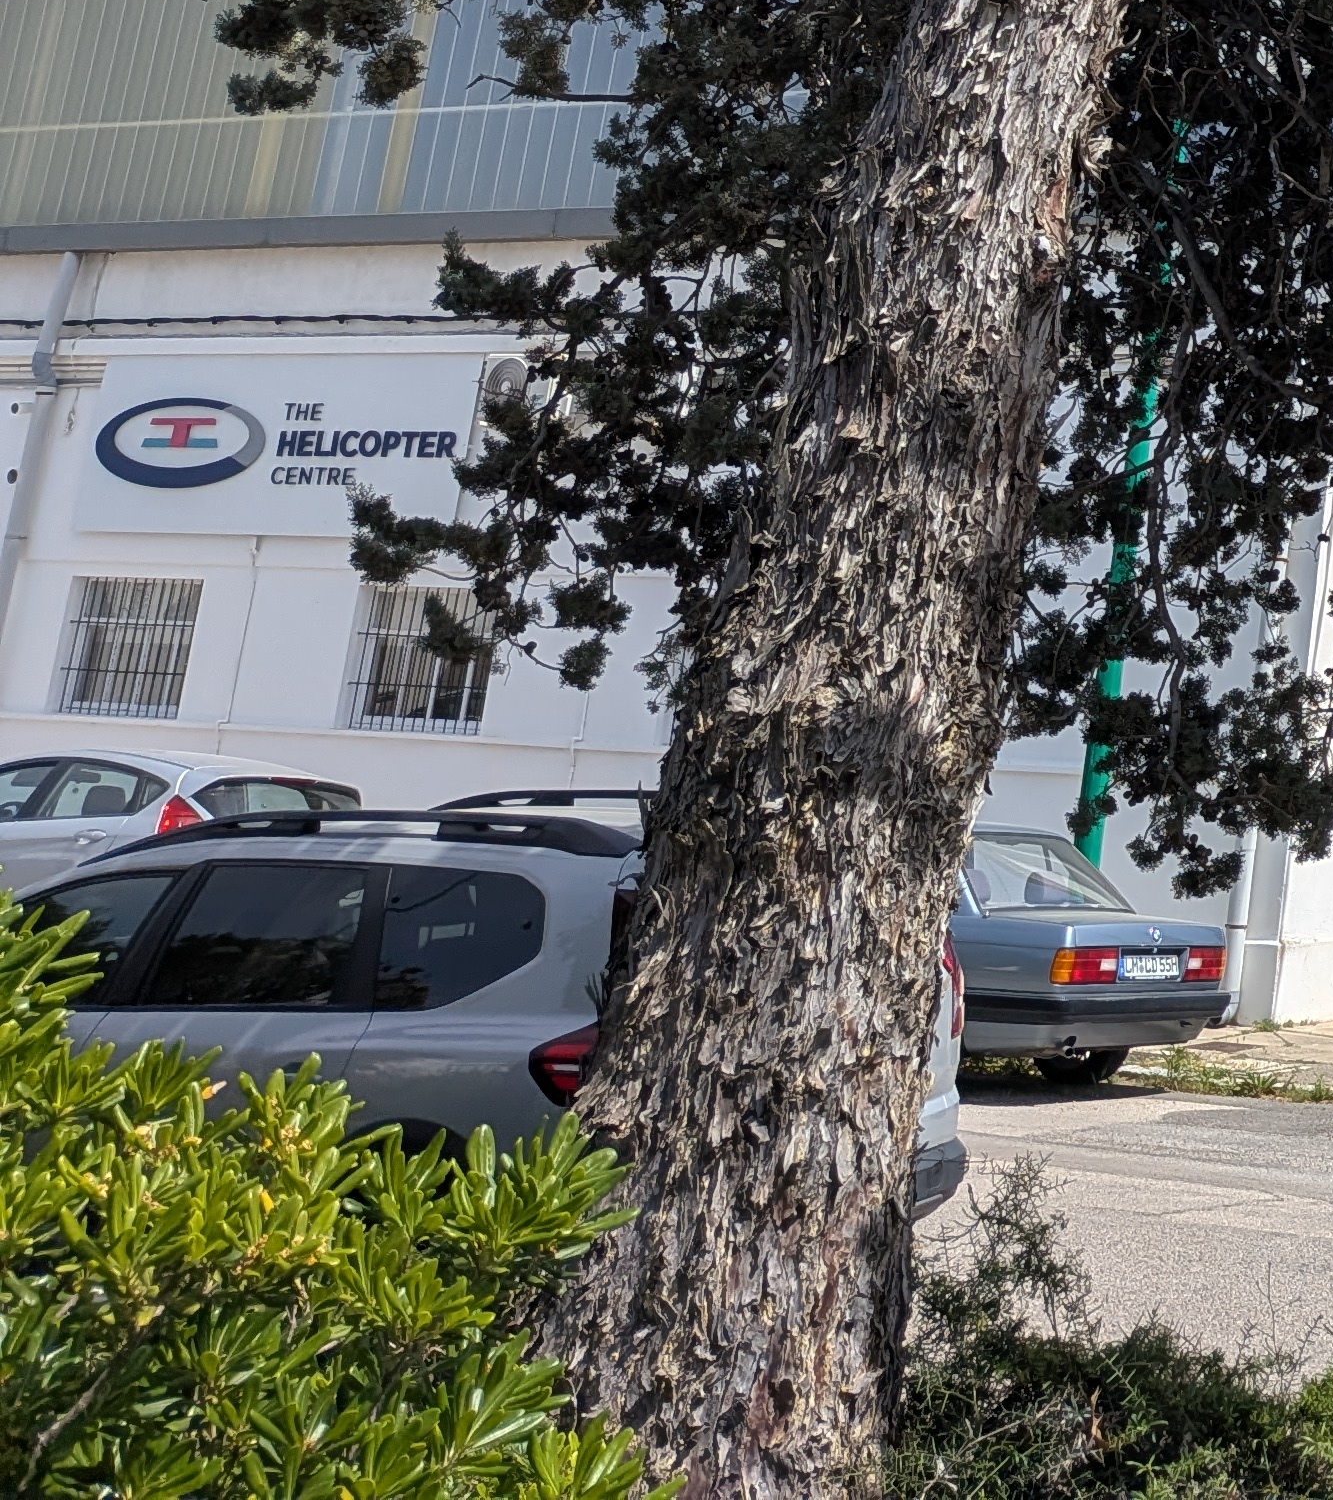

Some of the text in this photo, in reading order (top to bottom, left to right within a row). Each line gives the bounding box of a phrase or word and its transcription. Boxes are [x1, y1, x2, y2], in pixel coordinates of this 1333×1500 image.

[284, 402, 324, 421] THE
[275, 430, 458, 458] HELICOPTER
[270, 466, 356, 486] CENTRE
